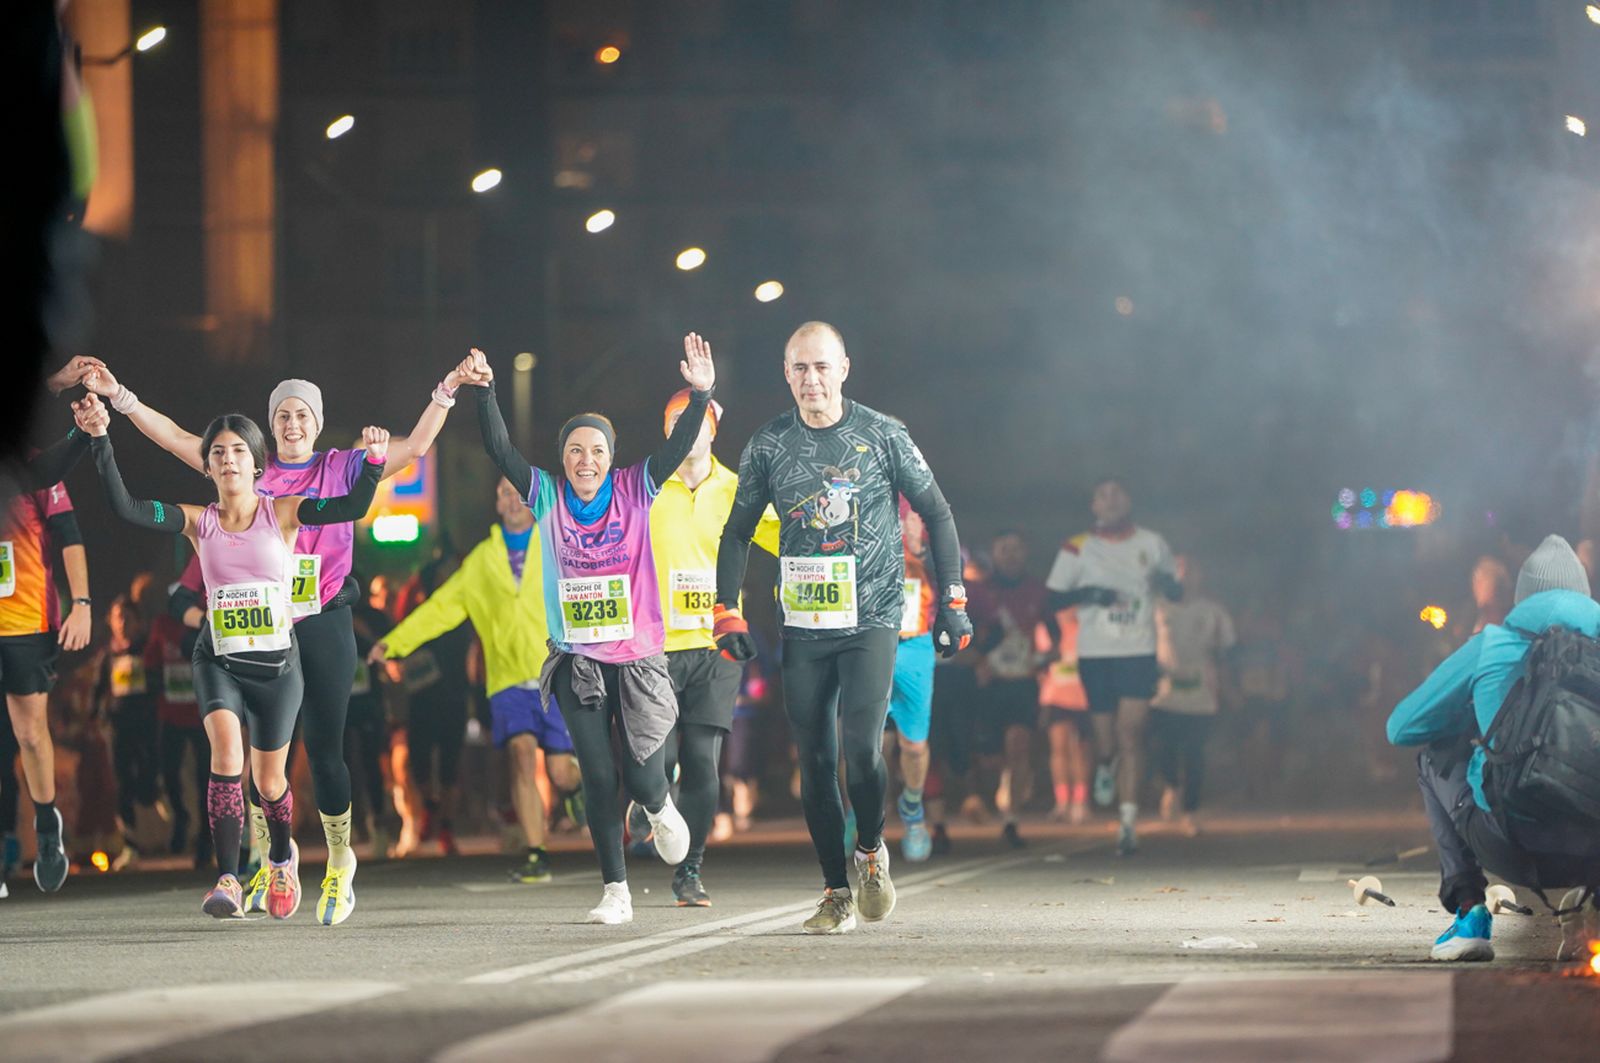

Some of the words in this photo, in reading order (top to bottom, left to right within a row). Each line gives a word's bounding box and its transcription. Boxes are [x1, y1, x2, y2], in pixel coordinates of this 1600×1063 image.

[560, 547, 581, 558] CLUB
[571, 585, 592, 593] NOCHE
[593, 583, 602, 591] DE
[796, 582, 839, 604] 1446
[248, 590, 259, 598] DE
[217, 600, 233, 609] SAN
[571, 599, 618, 621] 3233
[223, 607, 273, 629] 5300
